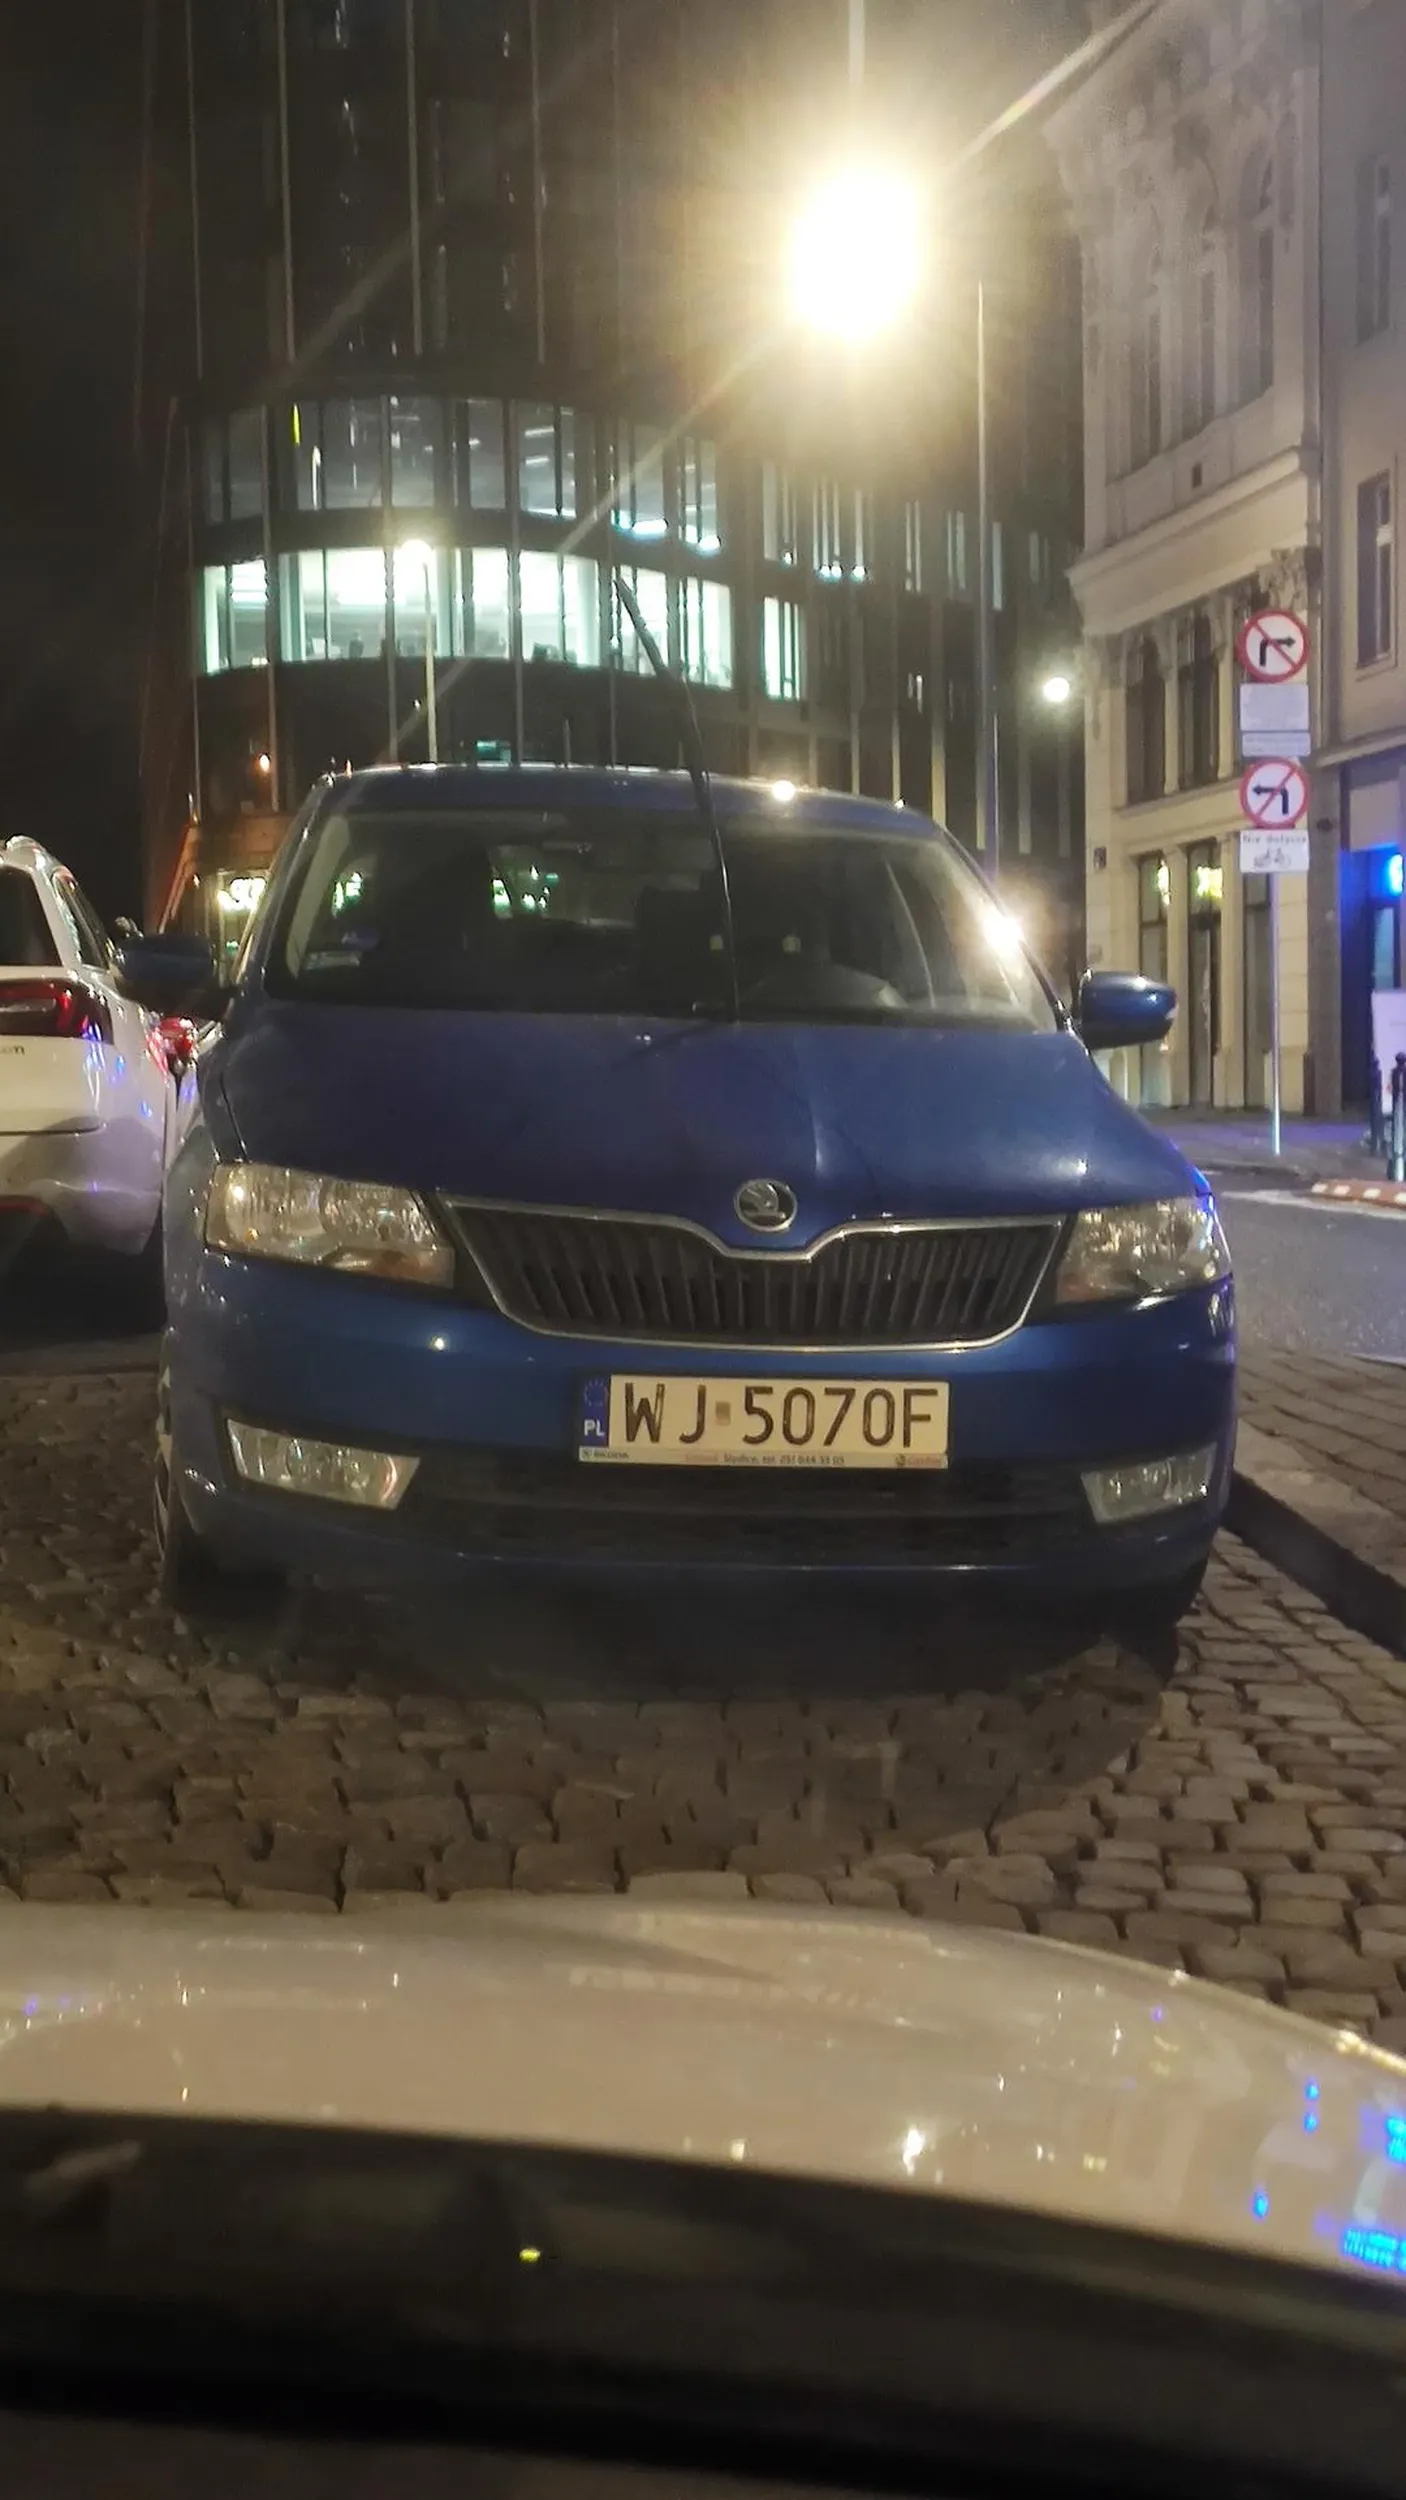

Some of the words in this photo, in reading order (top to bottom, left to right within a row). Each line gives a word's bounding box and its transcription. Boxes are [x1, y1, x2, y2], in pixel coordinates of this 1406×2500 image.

[583, 1419, 606, 1437] PL
[624, 1382, 707, 1445] WJ
[742, 1385, 939, 1448] 5070F
